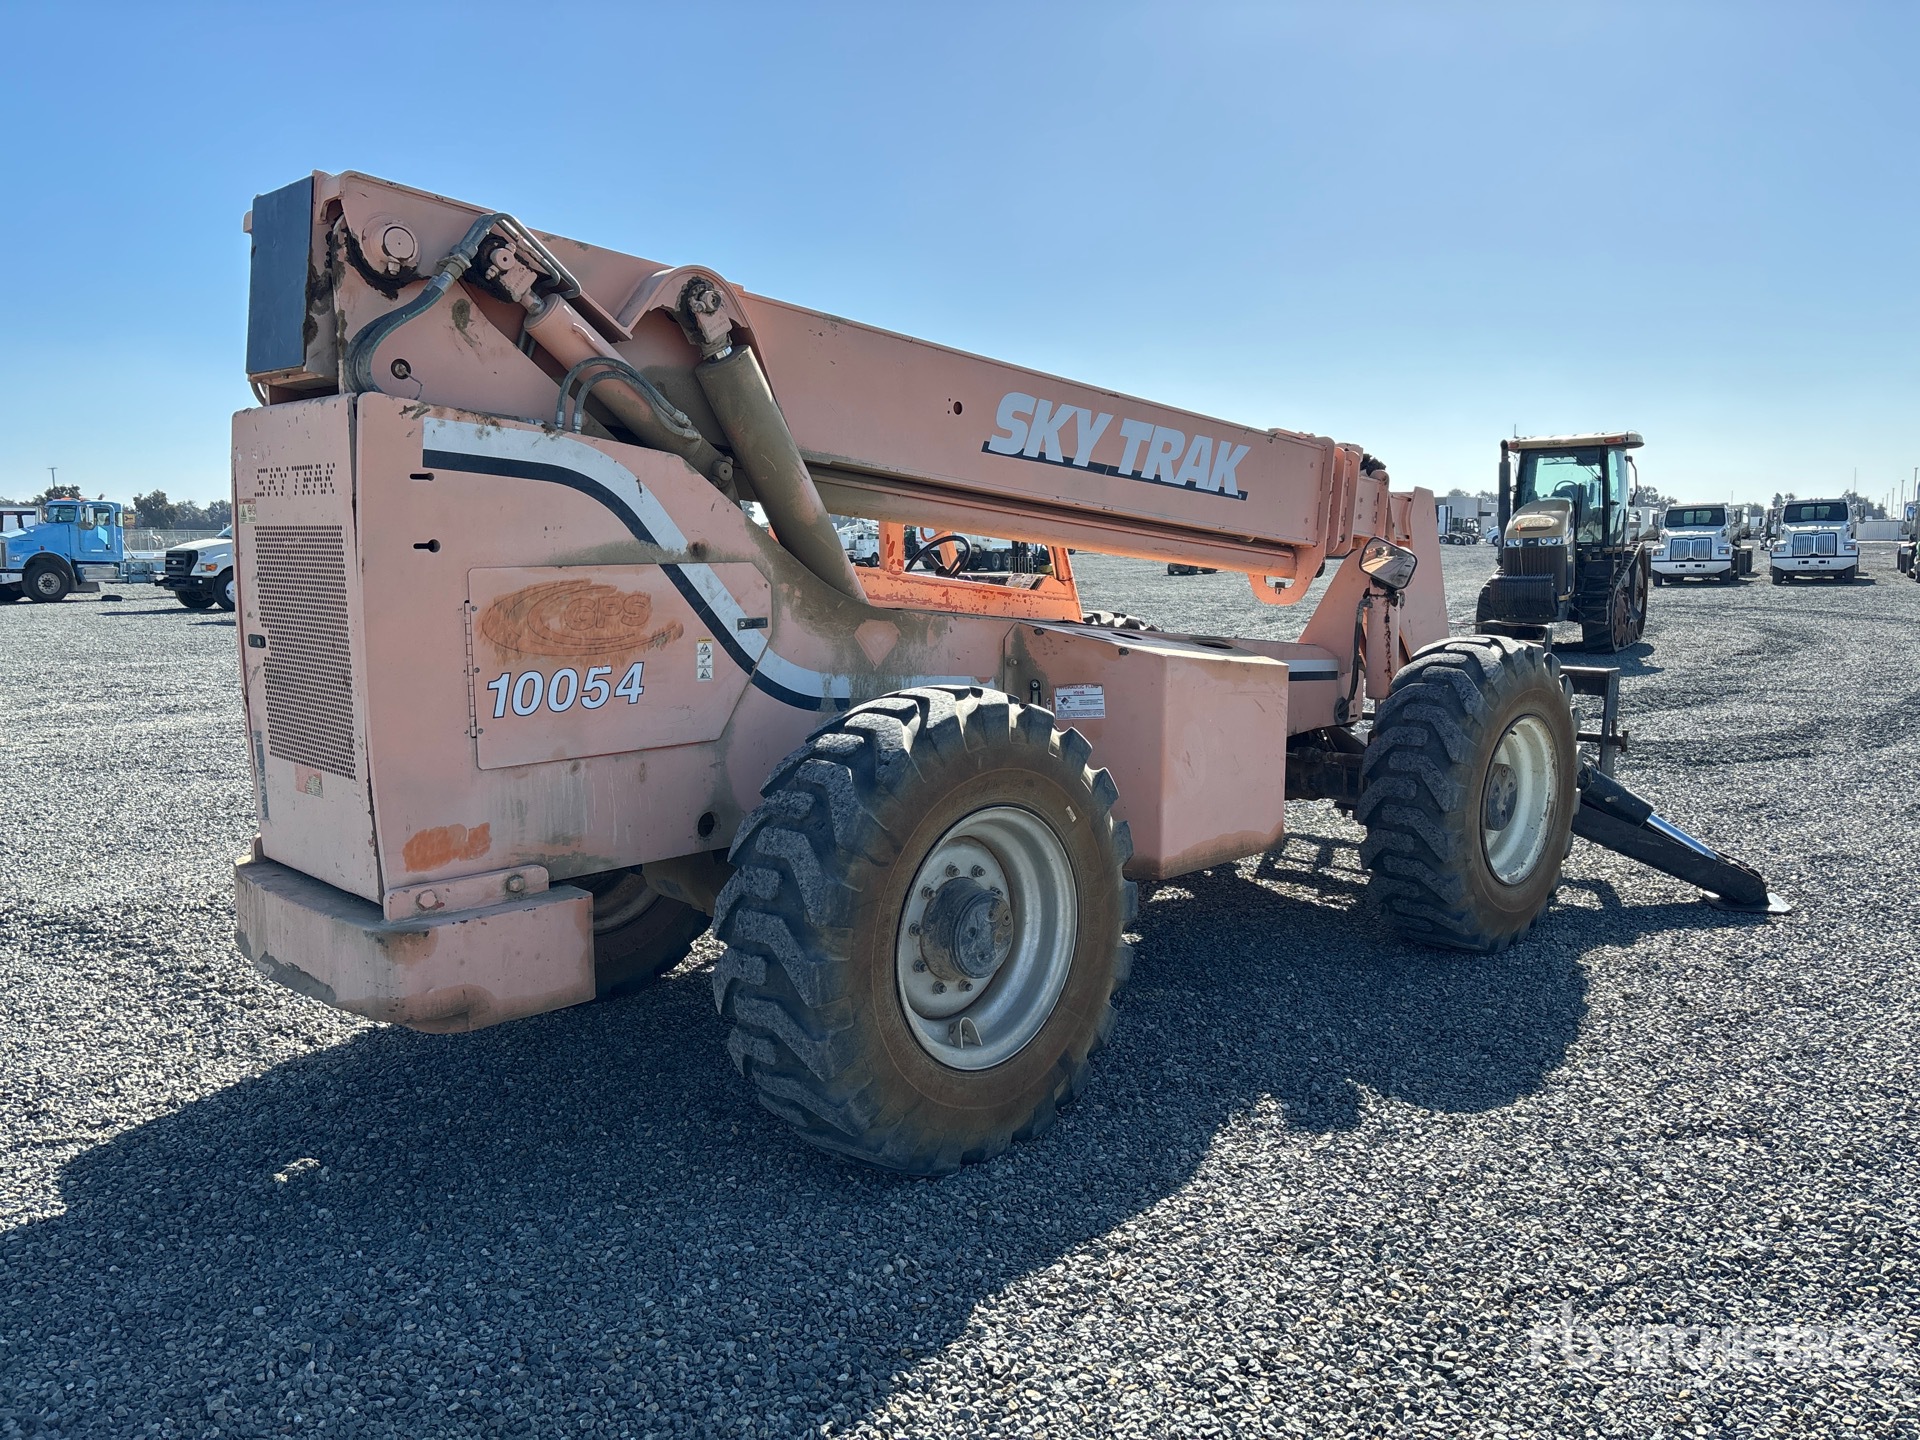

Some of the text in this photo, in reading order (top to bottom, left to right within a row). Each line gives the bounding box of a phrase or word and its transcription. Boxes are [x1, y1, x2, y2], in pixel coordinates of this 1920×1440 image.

[988, 391, 1251, 496] SKY TRAK
[254, 462, 336, 497] SKY TRAK
[487, 661, 645, 718] 10054
